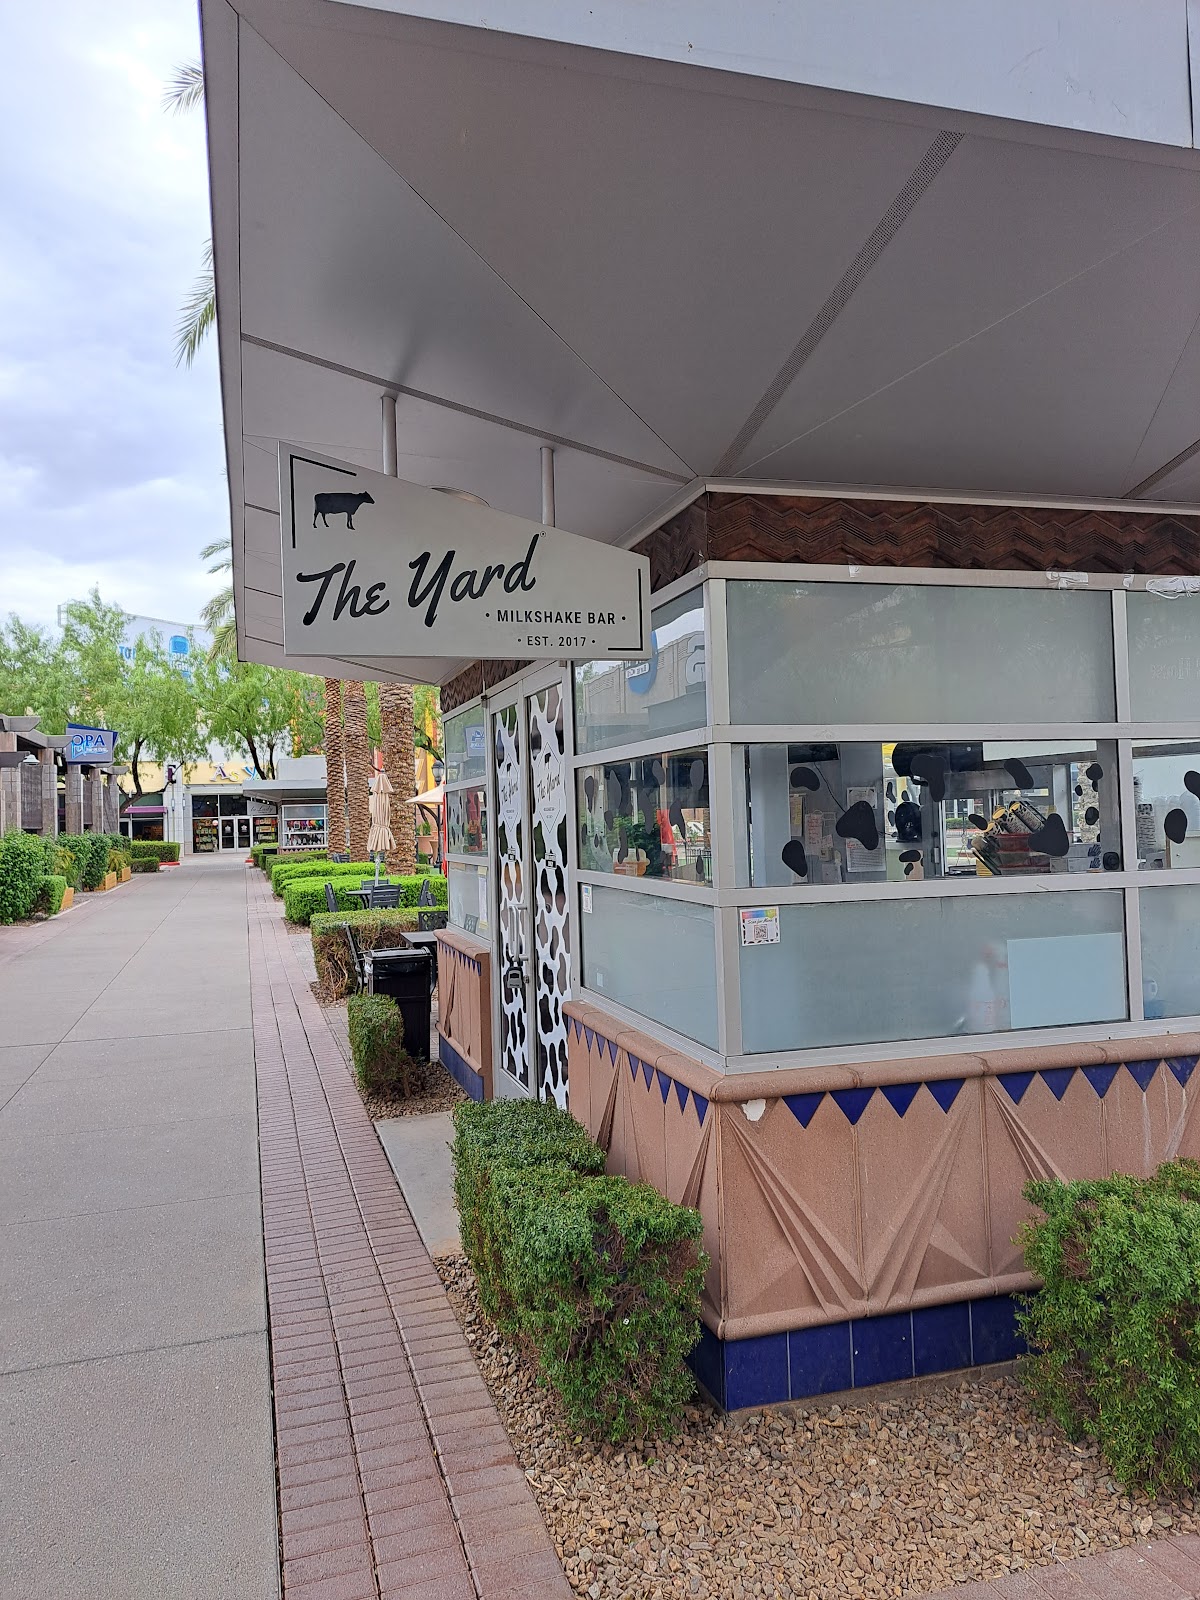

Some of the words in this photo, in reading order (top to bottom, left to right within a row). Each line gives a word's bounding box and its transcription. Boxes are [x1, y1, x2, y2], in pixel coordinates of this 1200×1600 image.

[296, 559, 390, 626] The
[407, 533, 540, 628] Yard
[497, 610, 582, 624] MILKSHAKE
[587, 612, 616, 625] BAR
[526, 635, 554, 647] EST.
[558, 636, 587, 647] 2017
[72, 734, 105, 747] OPA
